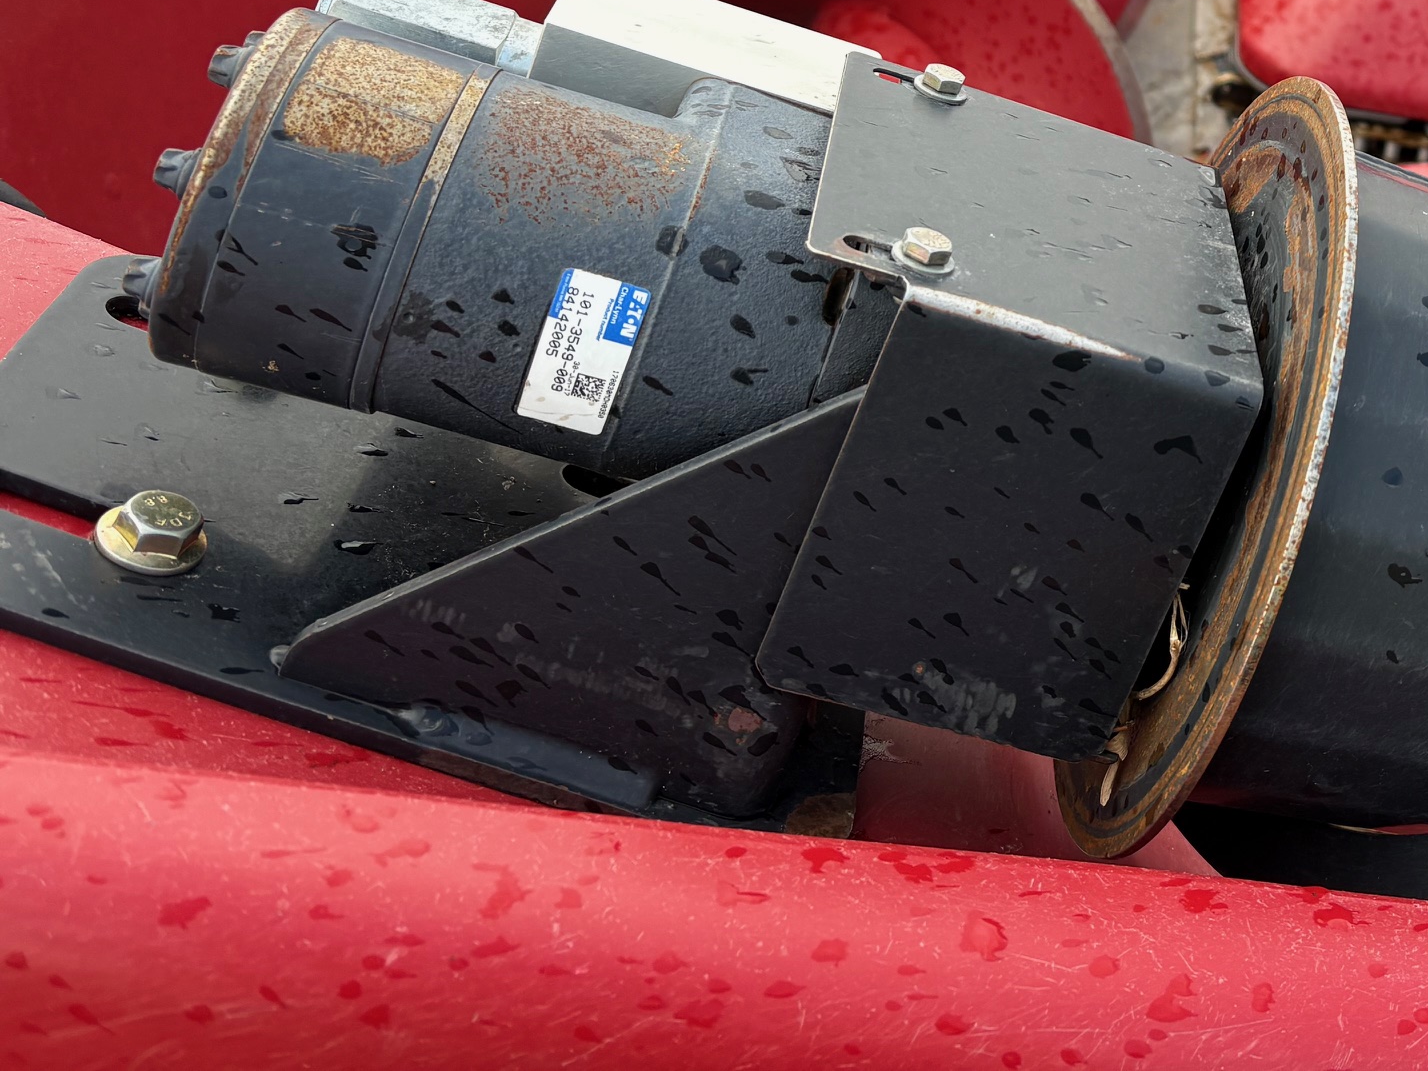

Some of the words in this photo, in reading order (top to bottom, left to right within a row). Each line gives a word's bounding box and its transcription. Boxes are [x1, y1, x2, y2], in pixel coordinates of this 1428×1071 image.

[545, 286, 580, 358] 84142005
[603, 298, 614, 320] Product
[610, 287, 629, 325] Char-Lynn
[620, 290, 649, 339] EATON
[551, 291, 595, 392] 101-3549-009
[596, 320, 606, 342] number
